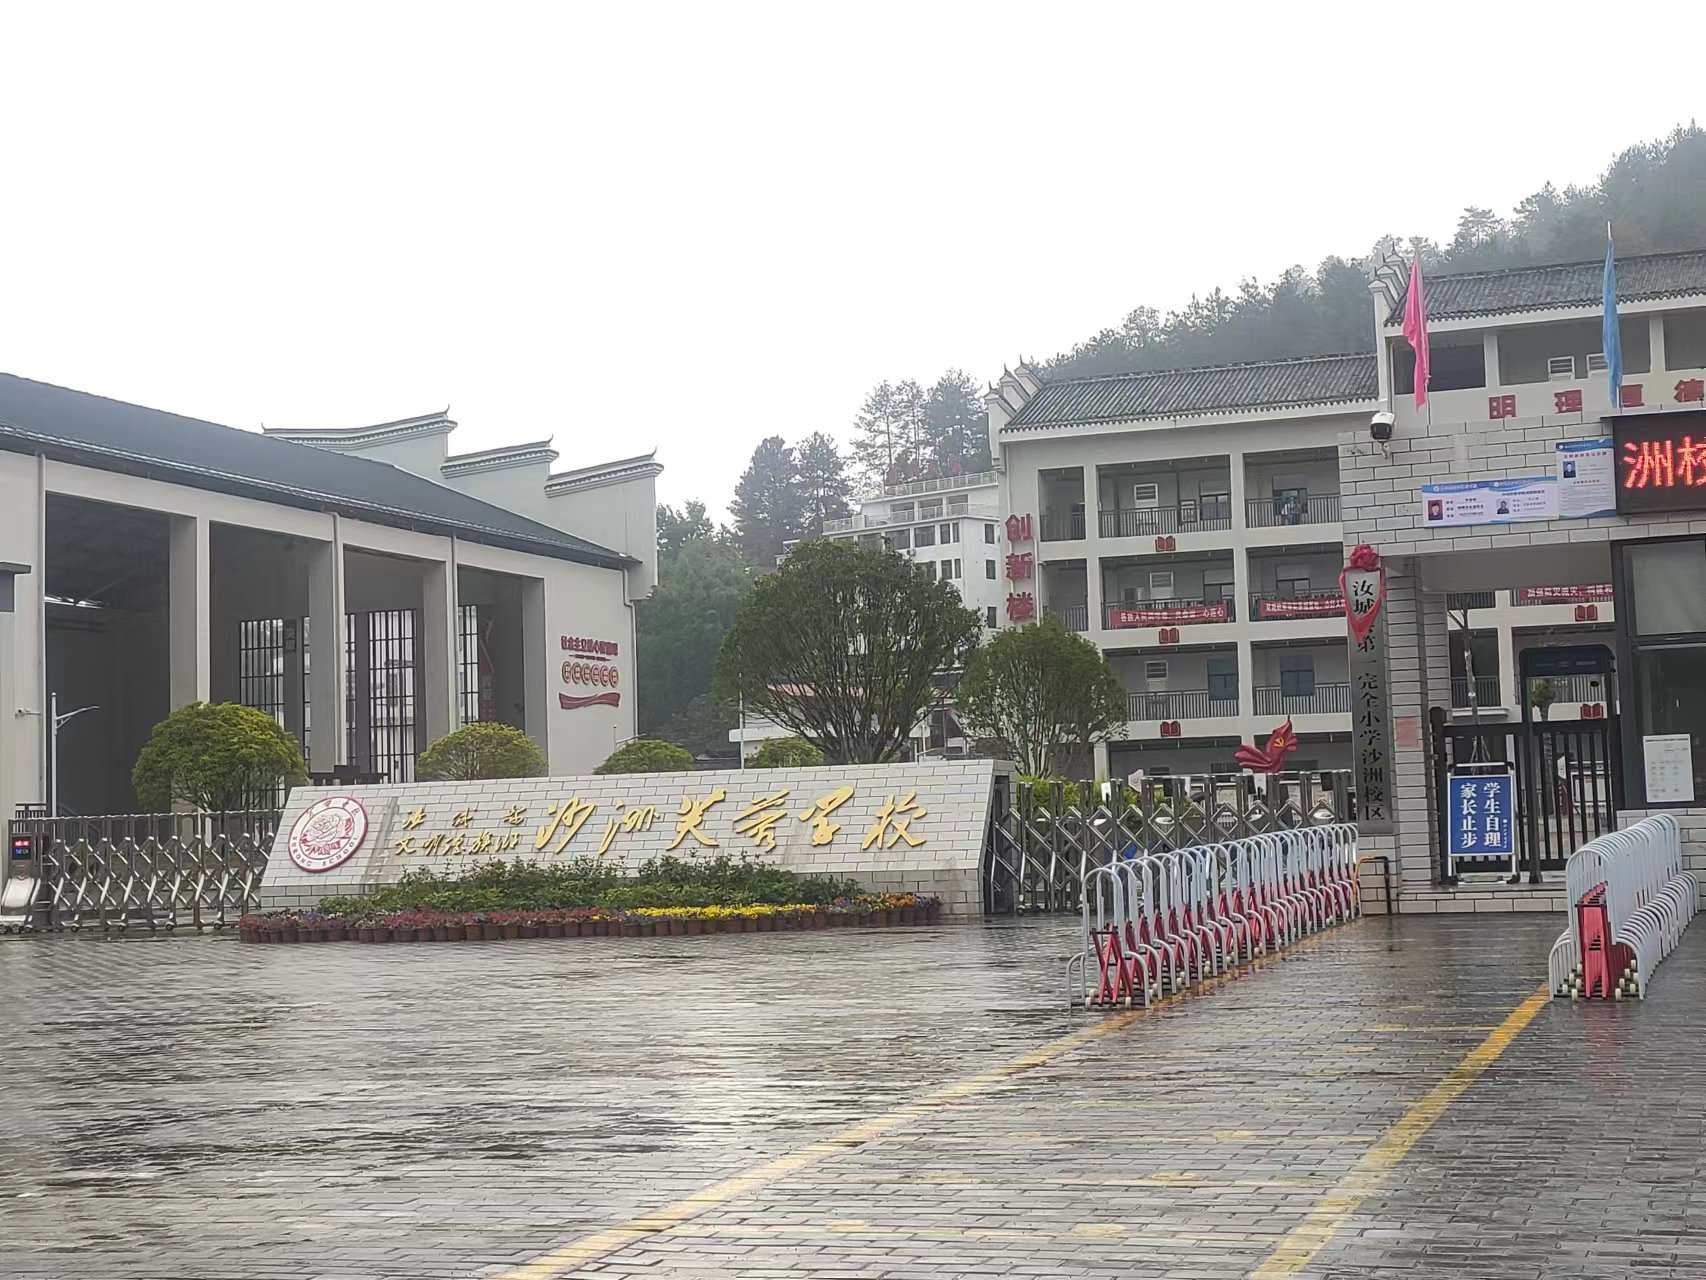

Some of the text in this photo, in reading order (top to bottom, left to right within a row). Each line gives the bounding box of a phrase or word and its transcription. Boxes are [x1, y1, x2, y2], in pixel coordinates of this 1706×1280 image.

[1005, 513, 1034, 621] 创新楼
[560, 636, 619, 657] 社会主核心
[1352, 580, 1386, 821] 汝城第一完全小学沙洲校区
[535, 786, 928, 855] 沙洲芙蓉学校
[1460, 783, 1478, 849] 家长止步
[1483, 782, 1502, 847] 学生自理
